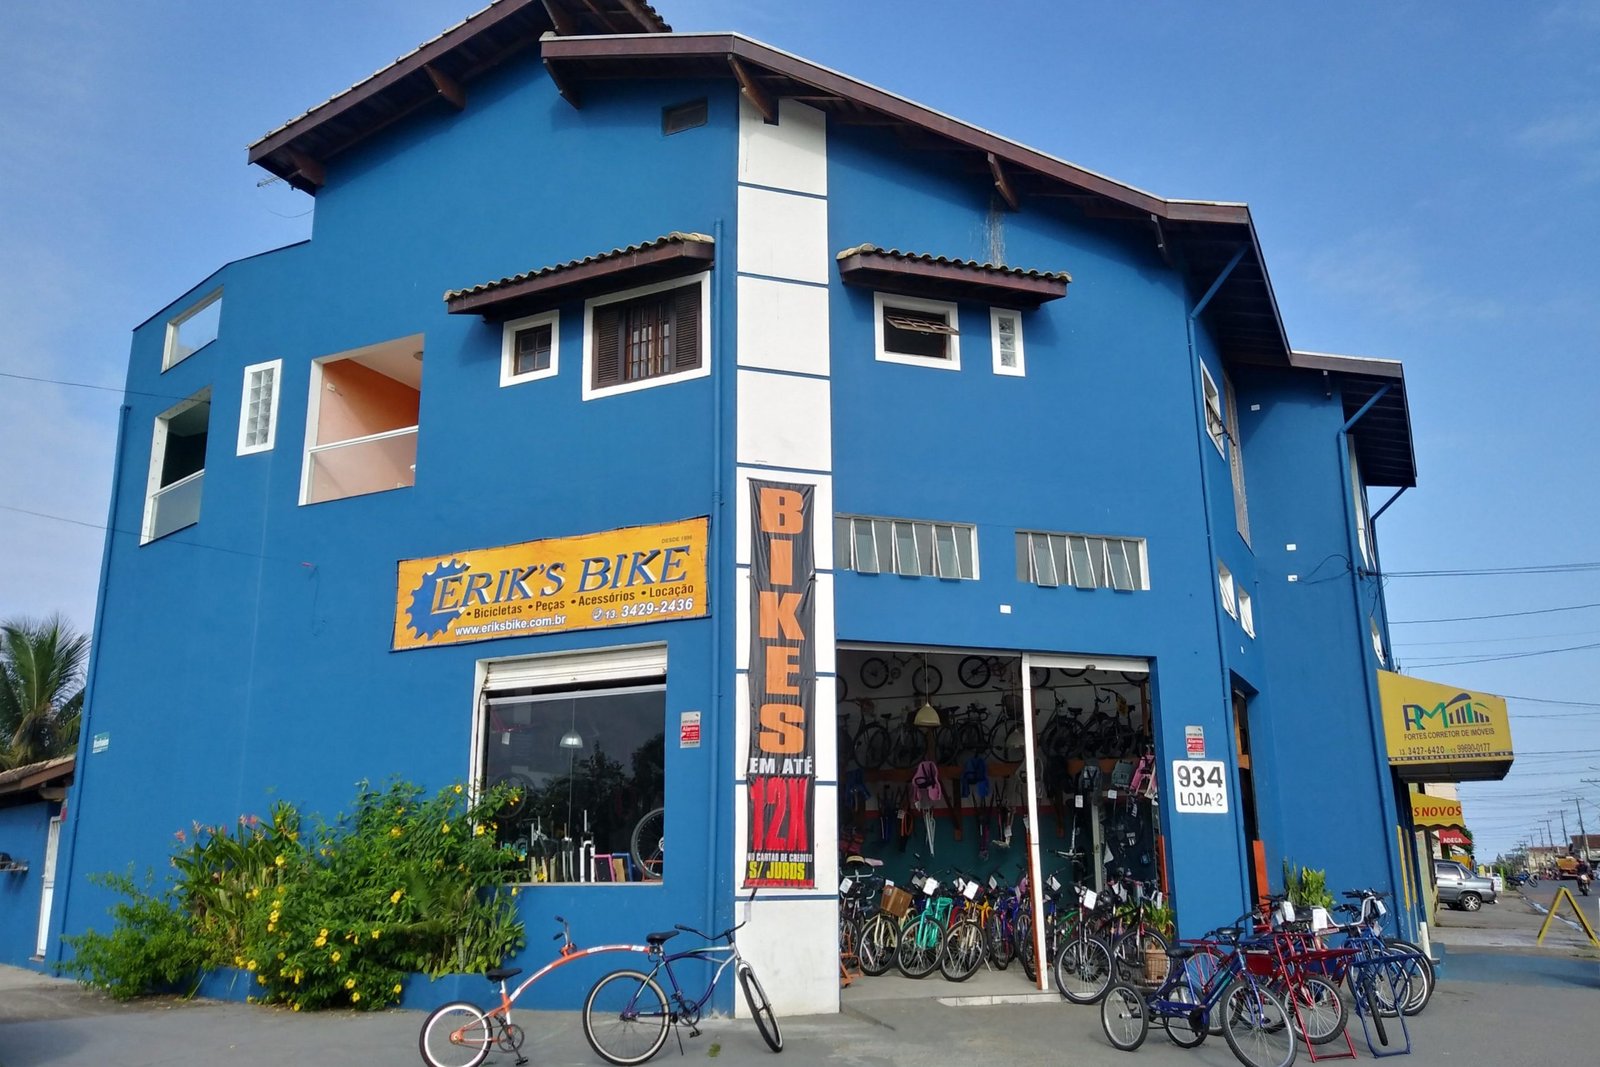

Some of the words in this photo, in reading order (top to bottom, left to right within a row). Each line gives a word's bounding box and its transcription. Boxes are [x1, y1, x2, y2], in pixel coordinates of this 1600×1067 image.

[435, 562, 566, 611] ERIK'S
[575, 545, 691, 593] BIKE
[474, 604, 523, 619] Bicicletas
[535, 600, 565, 612] Peças
[578, 590, 635, 607] Acessórios
[649, 585, 694, 598] Locação
[621, 598, 694, 618] 3429-2436
[455, 614, 566, 636] www.eriksbike.com.br
[759, 487, 805, 755] BIKES
[1404, 732, 1427, 741] FORTES
[1427, 730, 1460, 739] CORRETOR
[1461, 729, 1470, 737] DE
[1471, 727, 1495, 737] IMÓVEIS
[1408, 745, 1445, 755] 3427-6420
[749, 758, 775, 774] EM
[782, 756, 812, 774] ATÉ
[1177, 765, 1223, 788] 934
[750, 775, 808, 851] 12X
[1421, 806, 1462, 817] NOVOS
[781, 853, 788, 862] DE
[749, 861, 763, 878] S/
[766, 861, 805, 880] JUROS
